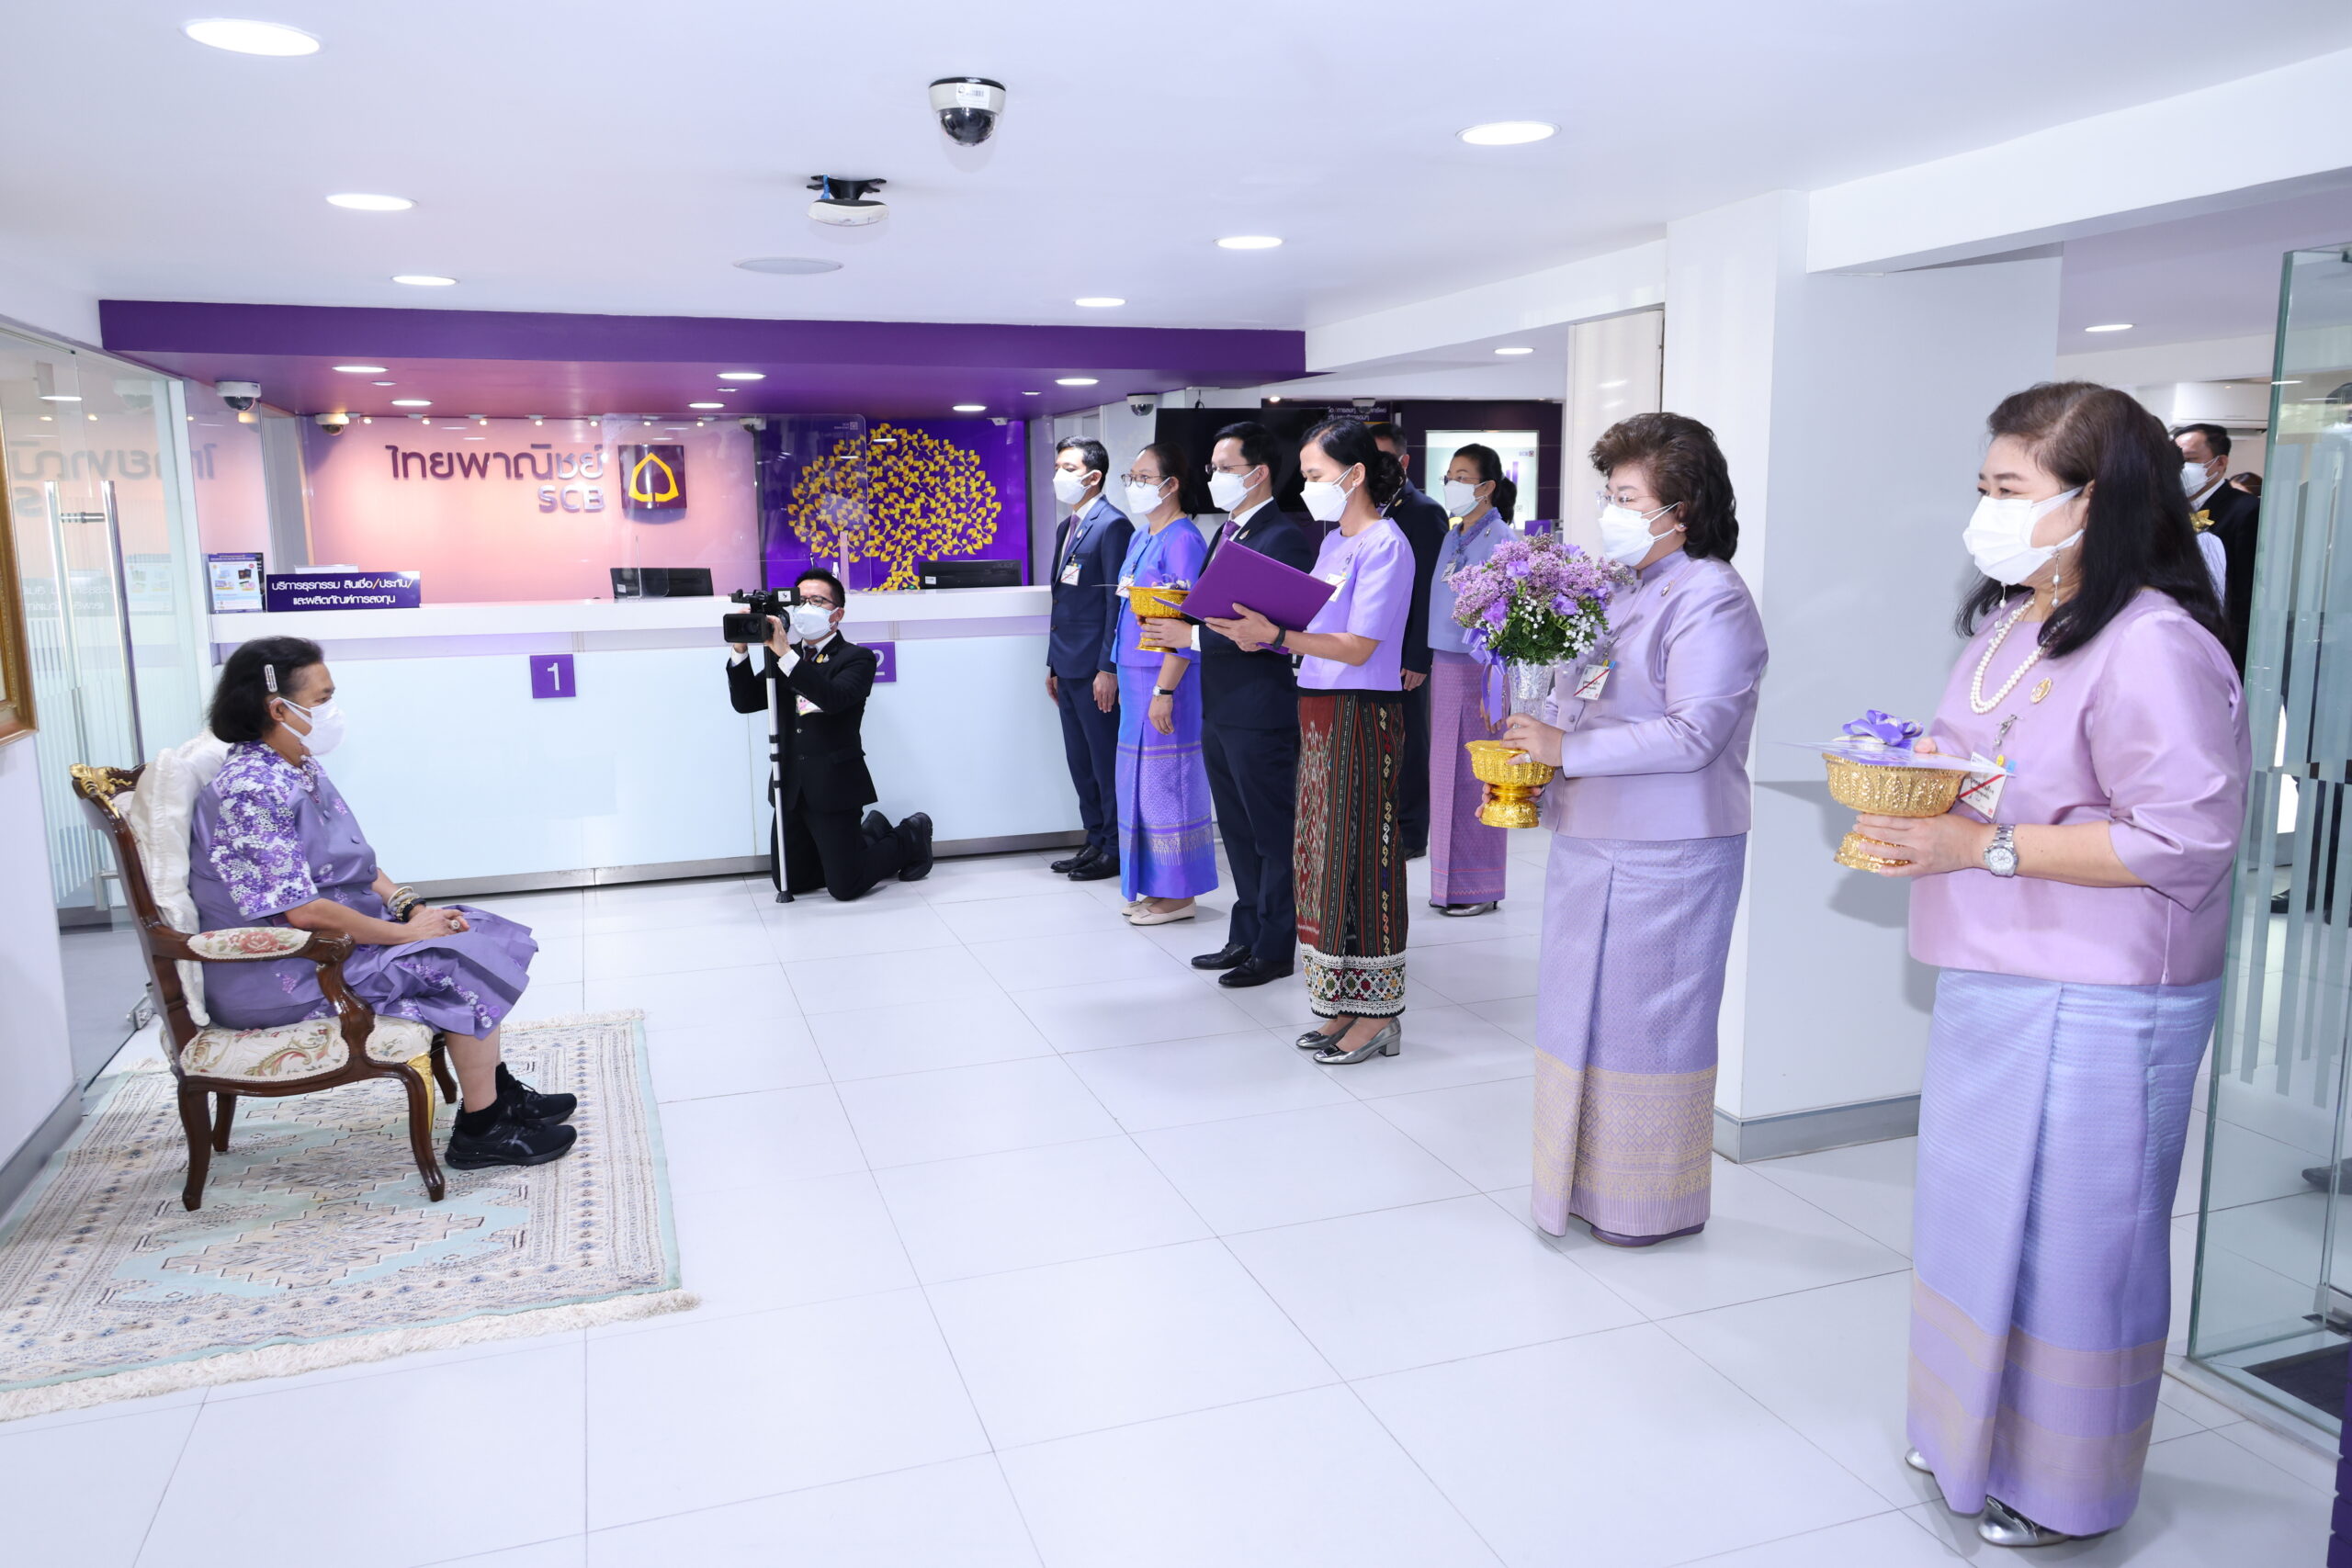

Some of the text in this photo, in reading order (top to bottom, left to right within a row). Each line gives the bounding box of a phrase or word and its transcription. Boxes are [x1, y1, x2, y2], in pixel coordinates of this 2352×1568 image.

[385, 444, 604, 479] ไทยพาณิชย์
[538, 484, 605, 513] SCB
[271, 581, 341, 592] บริการธุรกรรม
[547, 662, 560, 691] 1
[872, 649, 886, 676] 2
